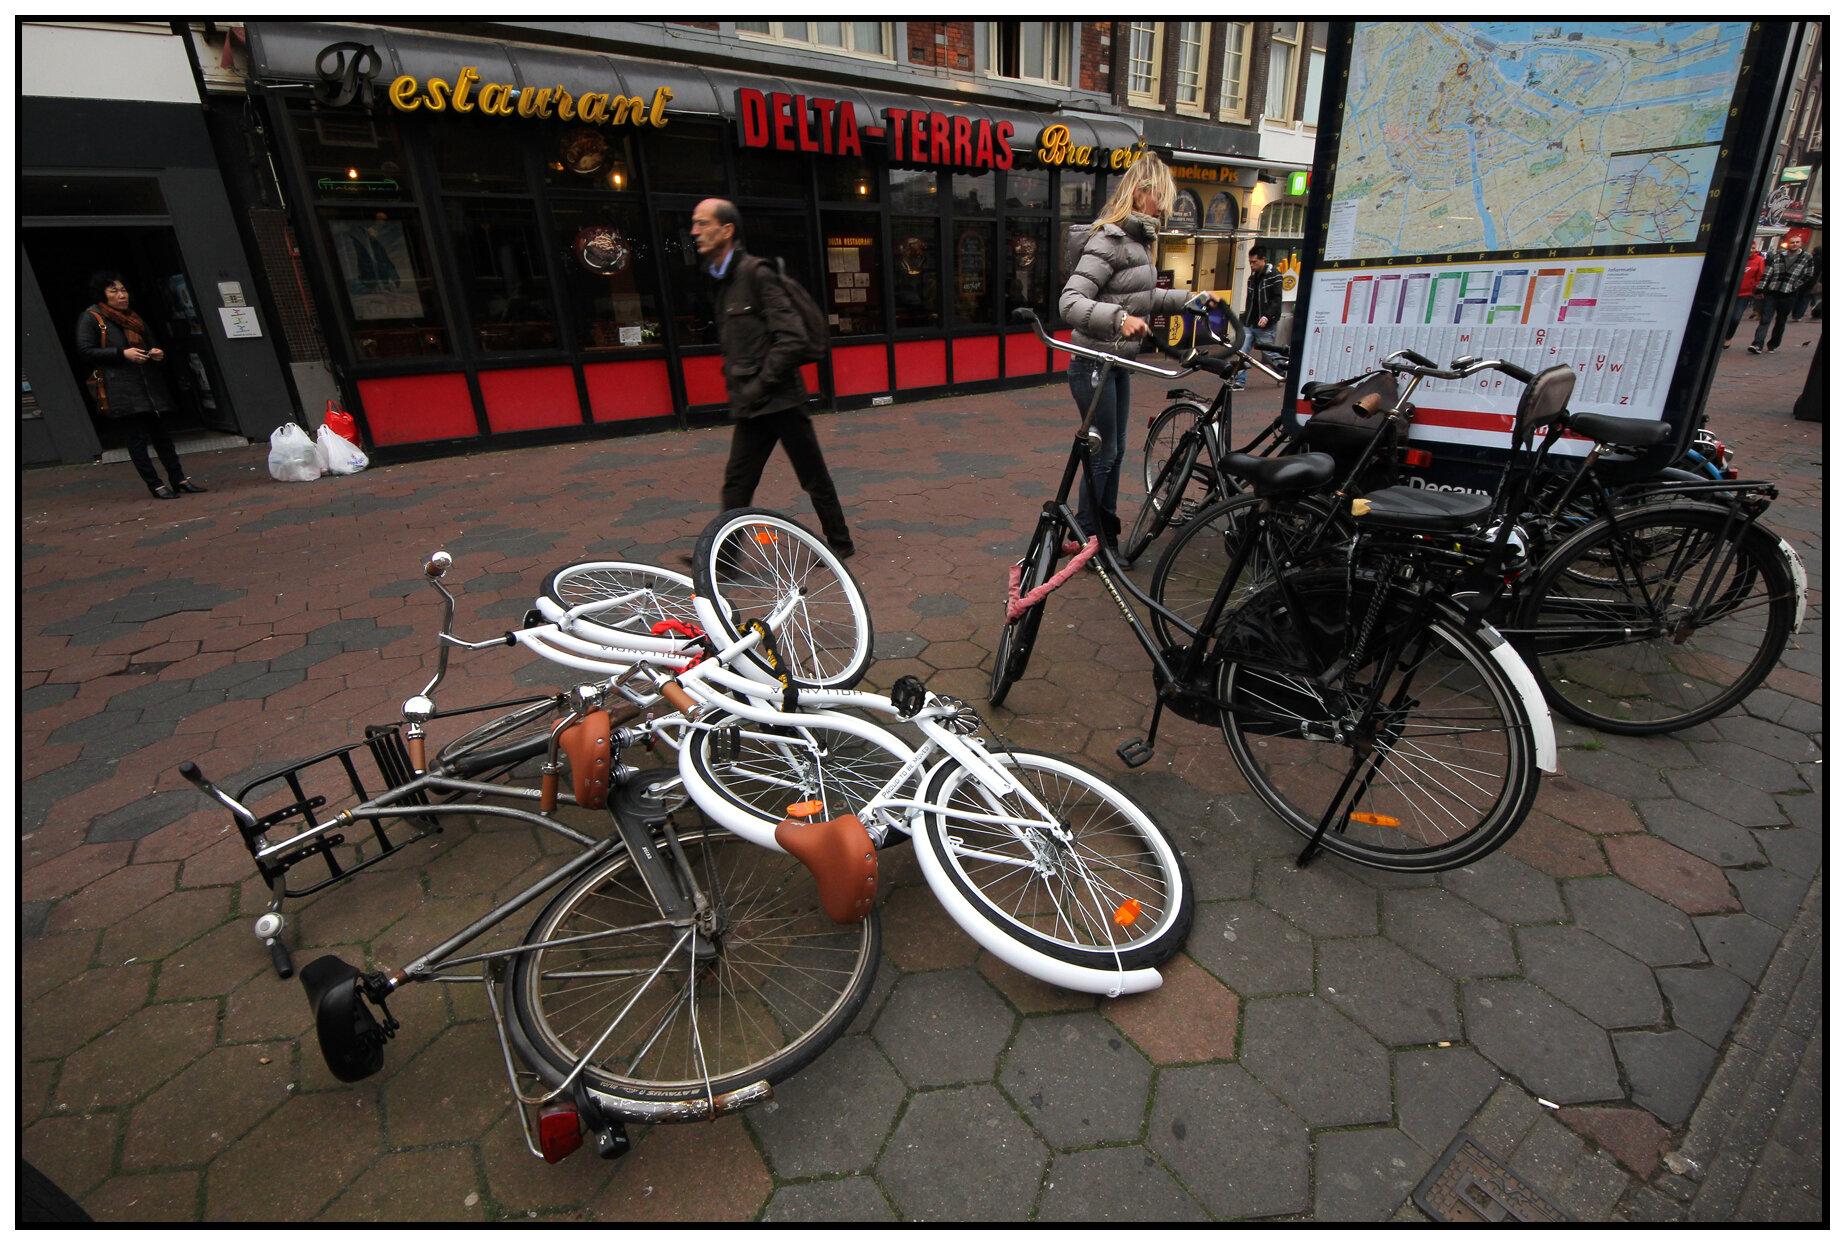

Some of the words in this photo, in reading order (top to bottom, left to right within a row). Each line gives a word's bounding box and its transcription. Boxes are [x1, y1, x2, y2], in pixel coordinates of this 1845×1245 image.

[314, 42, 675, 128] Restaurant
[1170, 163, 1217, 181] nneken
[1219, 166, 1239, 183] Pis
[1537, 329, 1546, 337] Q
[1460, 334, 1470, 342] M
[1535, 337, 1543, 345] R
[1597, 355, 1606, 363] U
[1610, 364, 1623, 372] W
[1480, 380, 1488, 388] O
[770, 686, 863, 697] HOLLANA
[881, 778, 901, 798] PROUD
